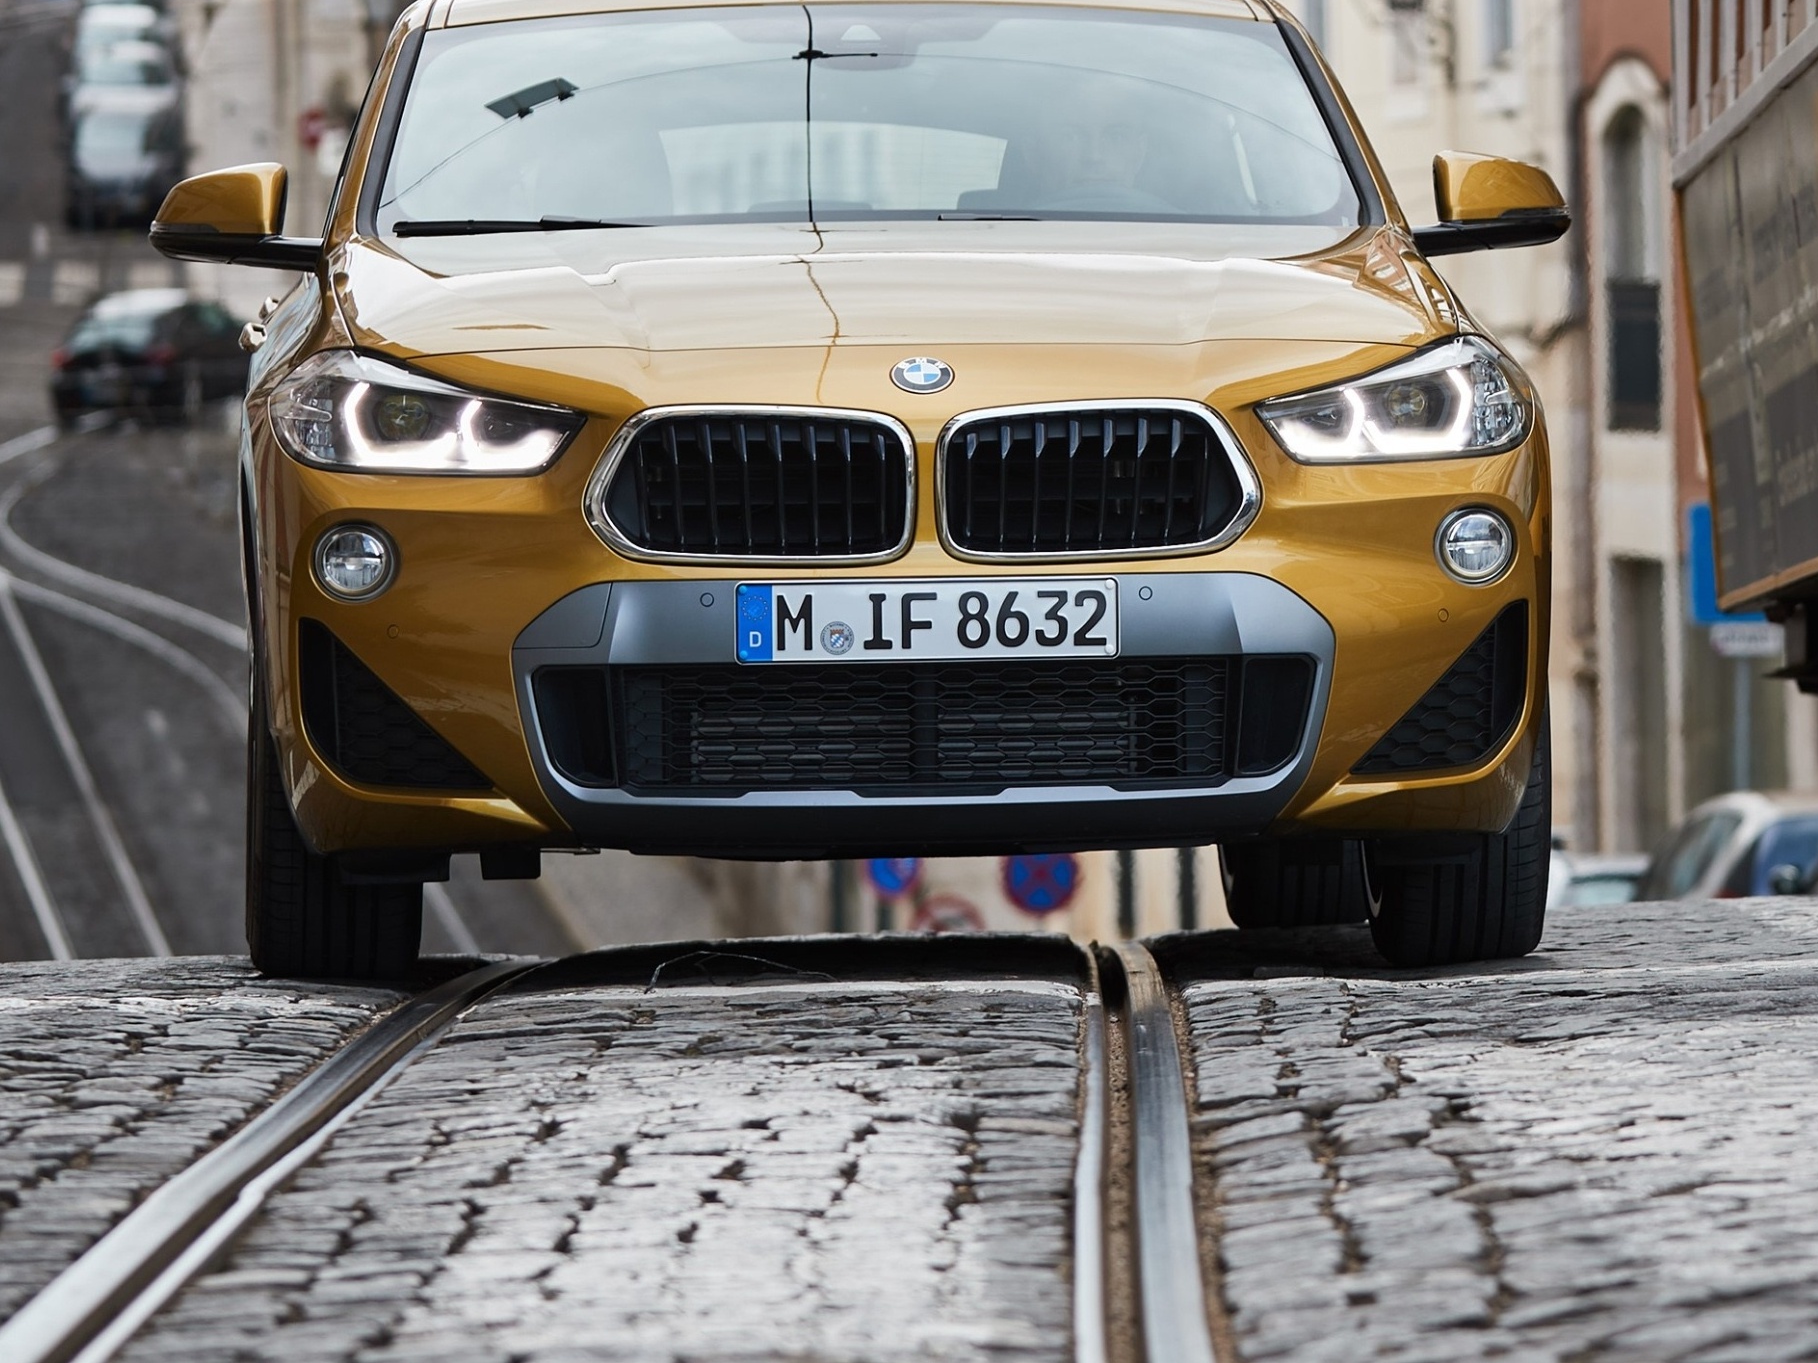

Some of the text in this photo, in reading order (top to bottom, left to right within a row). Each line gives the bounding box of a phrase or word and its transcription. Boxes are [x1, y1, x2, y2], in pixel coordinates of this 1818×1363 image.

[749, 630, 762, 648] D
[776, 593, 813, 651] M
[863, 591, 938, 651] IF
[956, 589, 1108, 649] 8632
